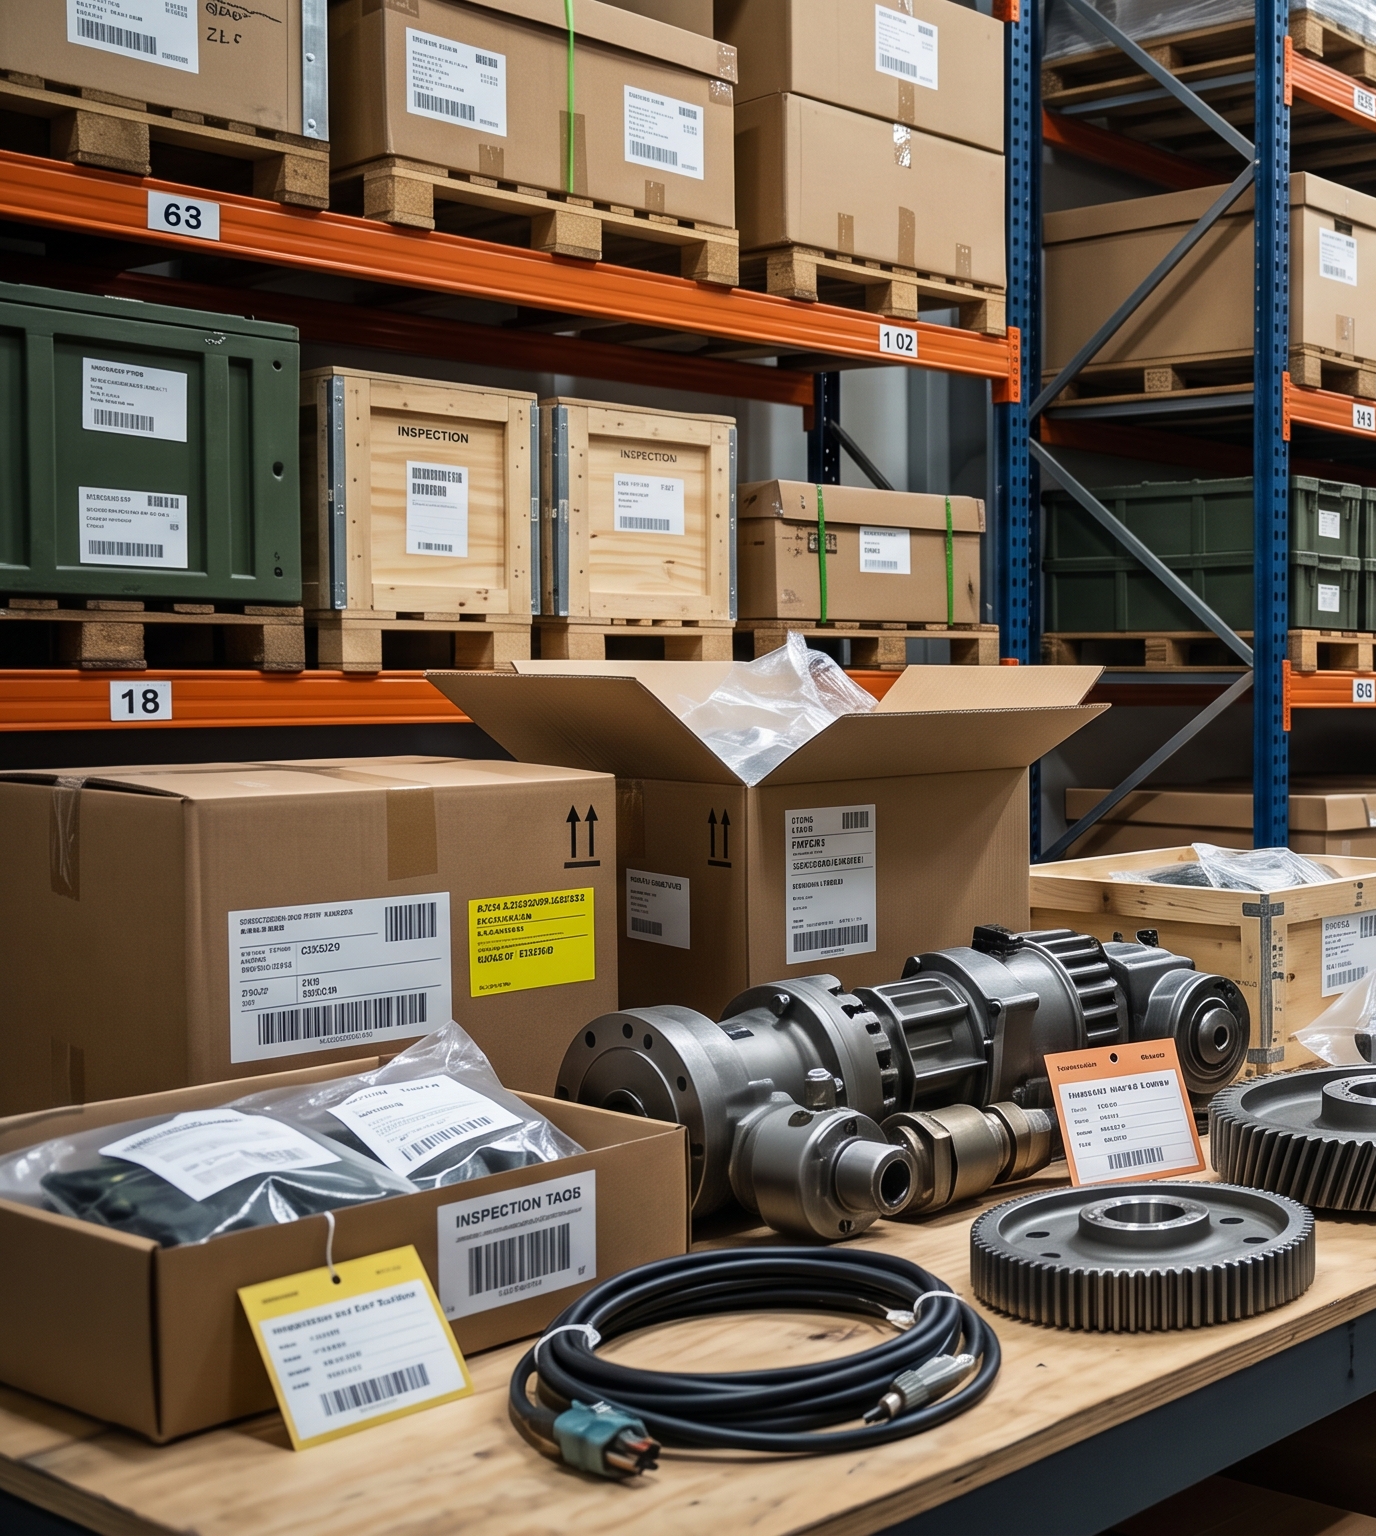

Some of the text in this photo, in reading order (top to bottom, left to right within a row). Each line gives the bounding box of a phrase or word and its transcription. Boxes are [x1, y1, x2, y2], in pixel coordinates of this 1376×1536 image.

[164, 203, 201, 230] 63
[397, 426, 469, 444] INSPECTION
[620, 449, 677, 463] INSPECTION
[121, 688, 160, 714] 18
[456, 1196, 542, 1229] INSPECTION
